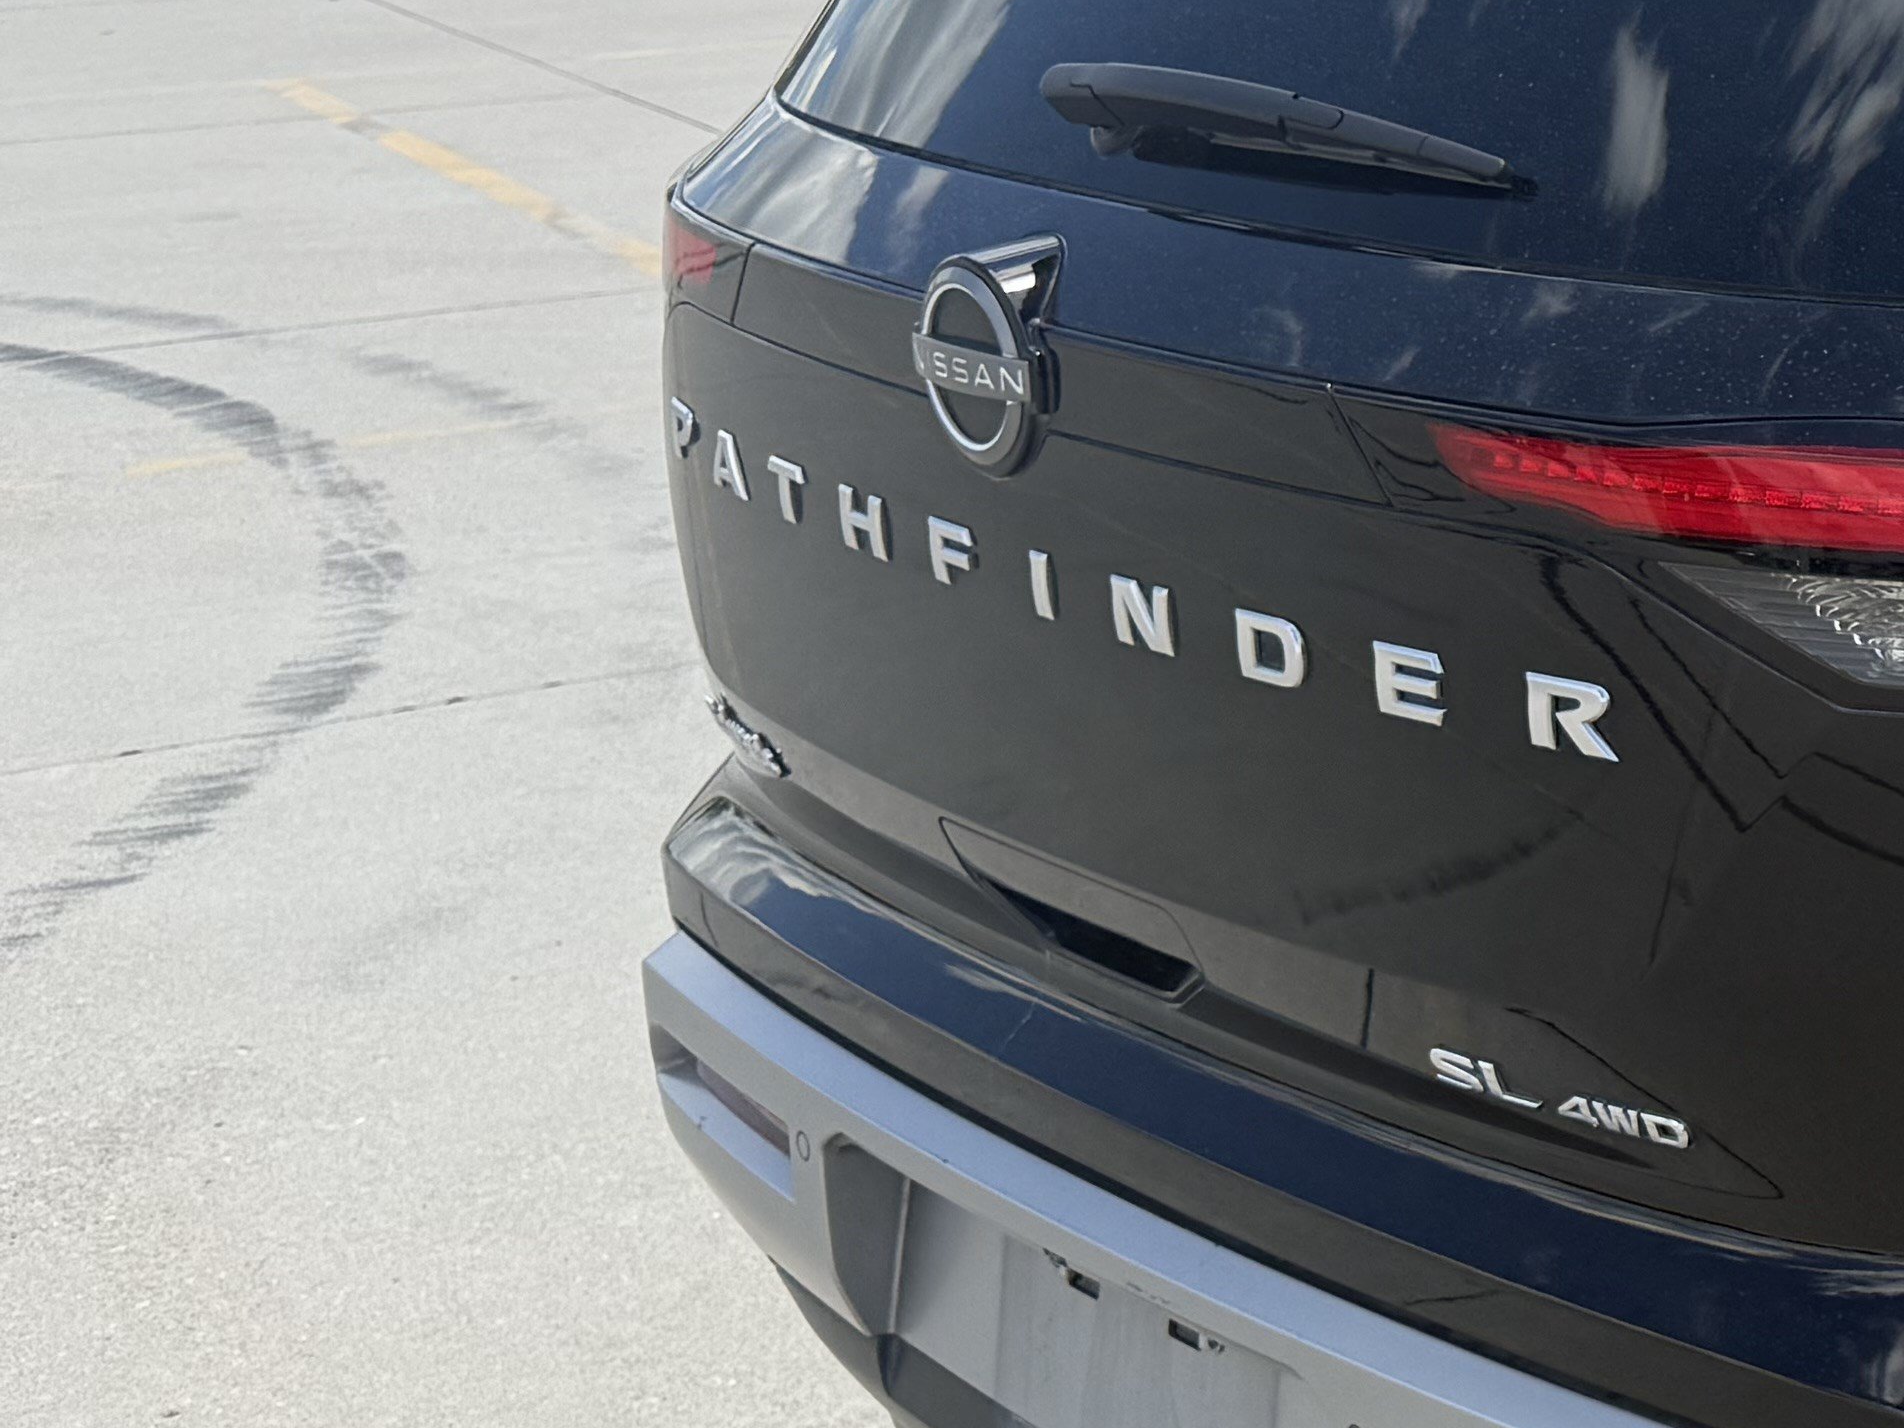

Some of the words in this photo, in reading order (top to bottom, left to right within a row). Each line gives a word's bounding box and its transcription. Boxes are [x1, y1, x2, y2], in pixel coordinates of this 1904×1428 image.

[671, 395, 1620, 763] PATHFINDER
[1429, 1047, 1544, 1110] SL
[1556, 1094, 1690, 1150] 4WD
